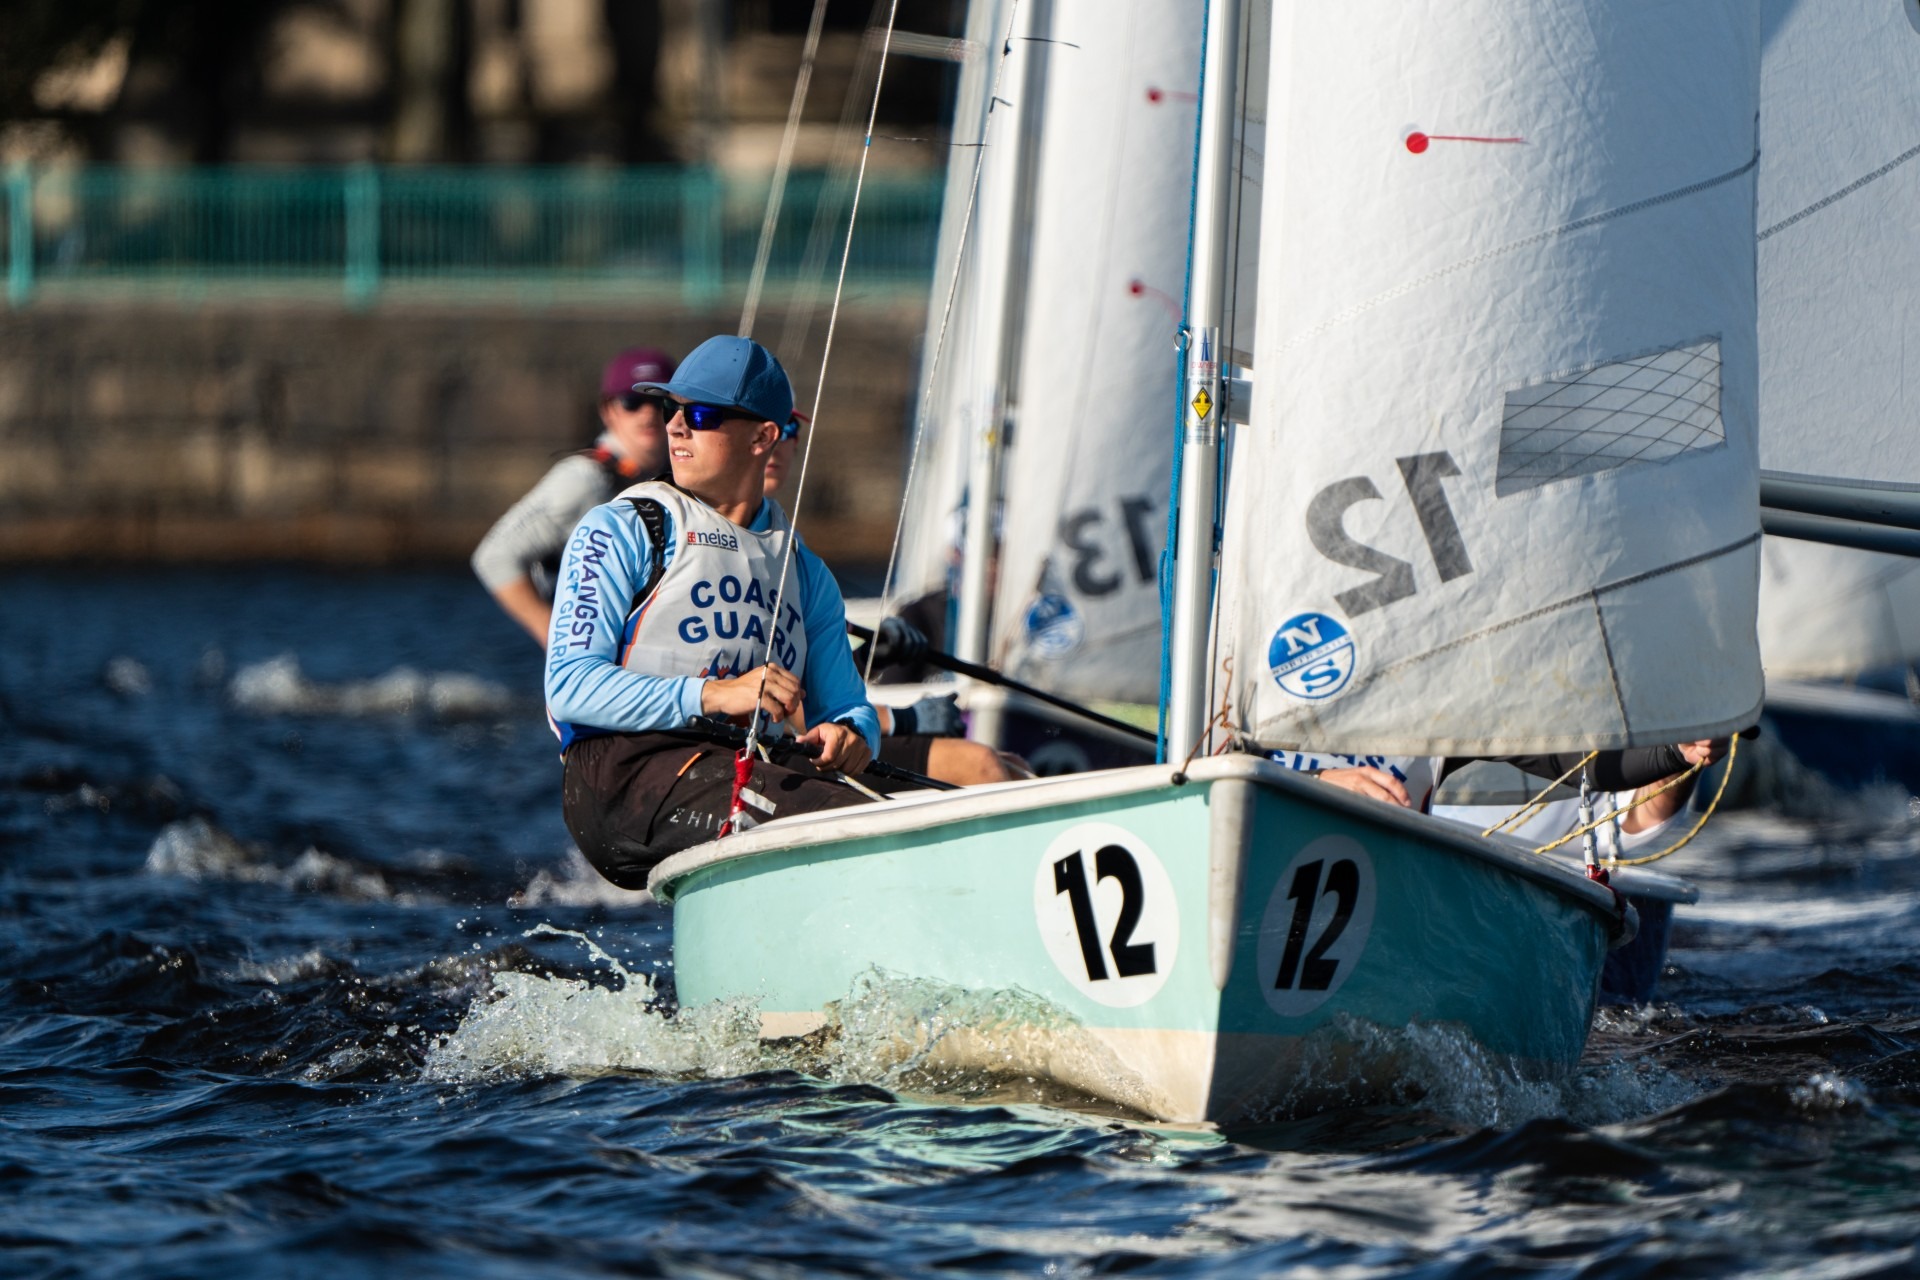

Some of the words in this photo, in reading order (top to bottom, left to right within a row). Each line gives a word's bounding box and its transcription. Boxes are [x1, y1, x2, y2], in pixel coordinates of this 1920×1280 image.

[566, 525, 591, 594] COAST
[697, 528, 739, 549] neisa
[569, 529, 613, 651] UNANGST
[690, 575, 802, 634] COAST
[678, 611, 797, 671] GUARD
[1279, 617, 1323, 656] N
[1300, 658, 1341, 694] S
[1053, 843, 1158, 982] 12
[1274, 857, 1361, 991] 12
